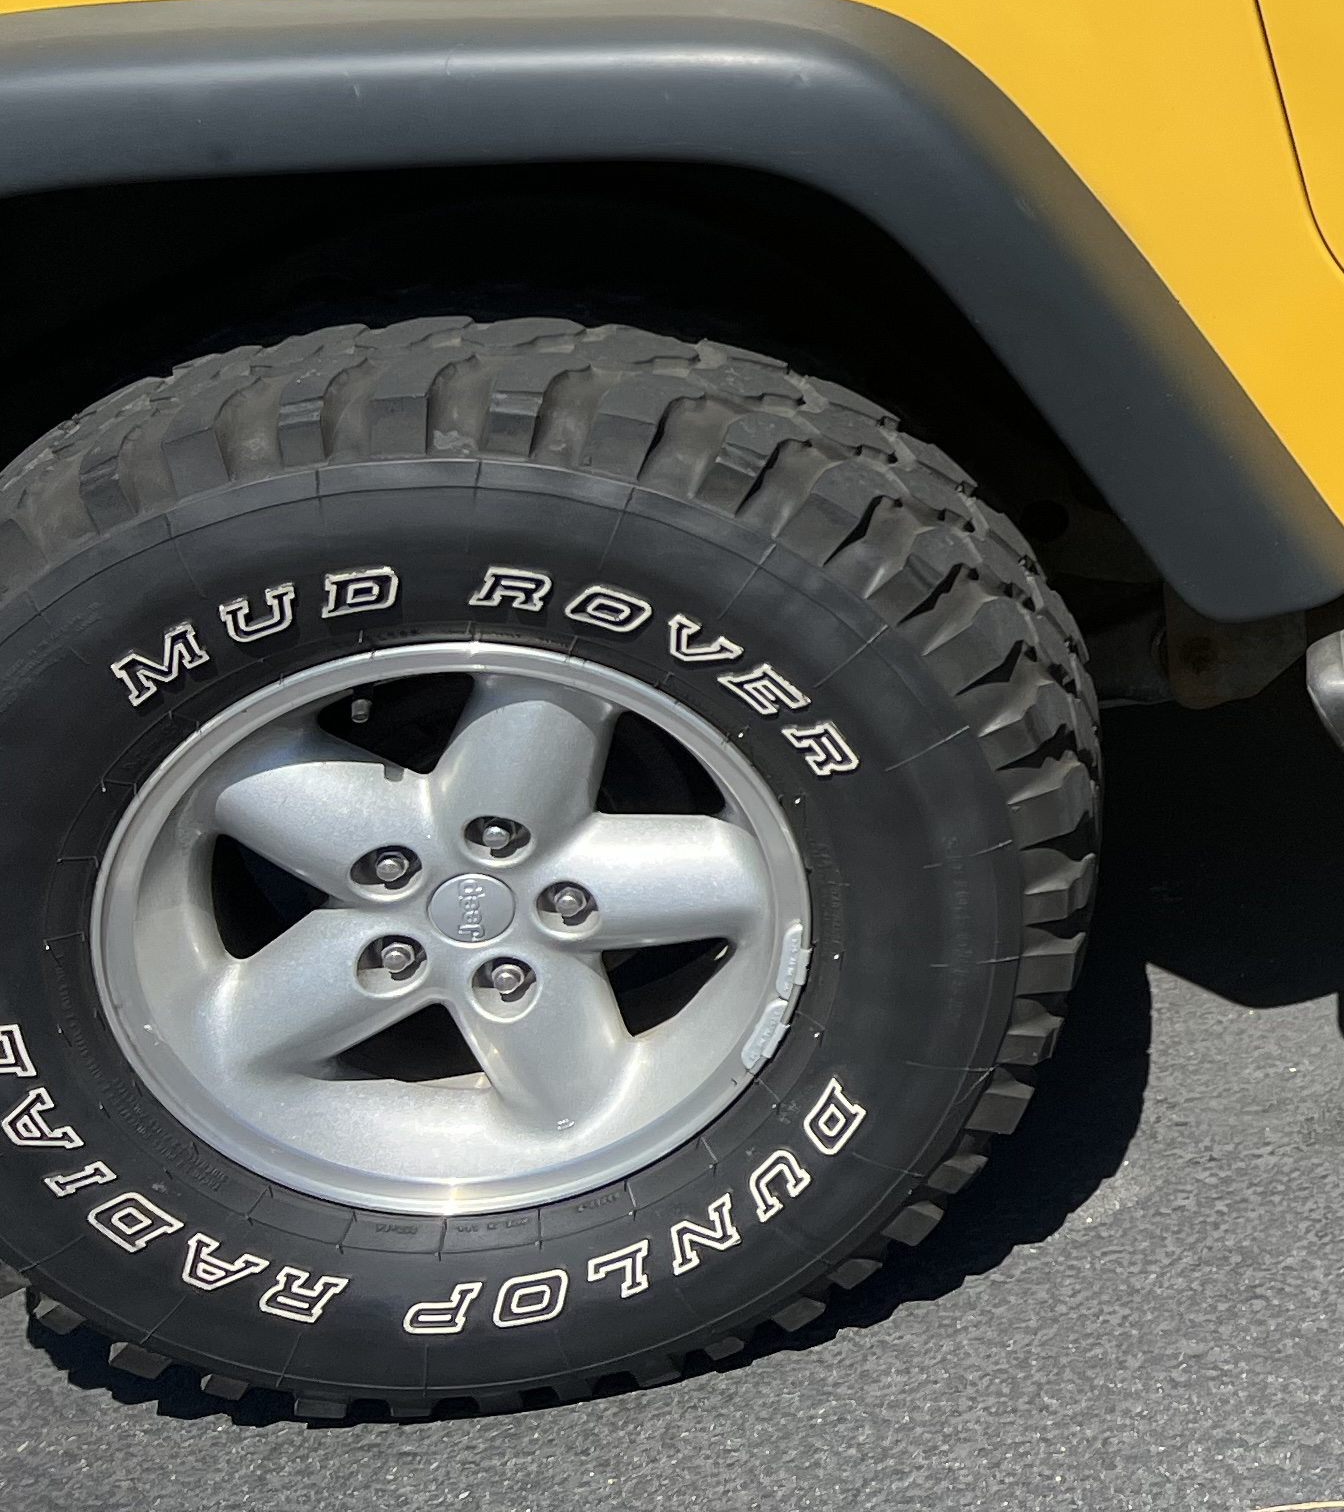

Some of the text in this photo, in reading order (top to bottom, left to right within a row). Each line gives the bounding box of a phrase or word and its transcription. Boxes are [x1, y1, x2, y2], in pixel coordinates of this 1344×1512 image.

[112, 566, 860, 778] MUD ROVER
[457, 878, 486, 942] Jeep
[402, 1078, 868, 1335] DUNLOP
